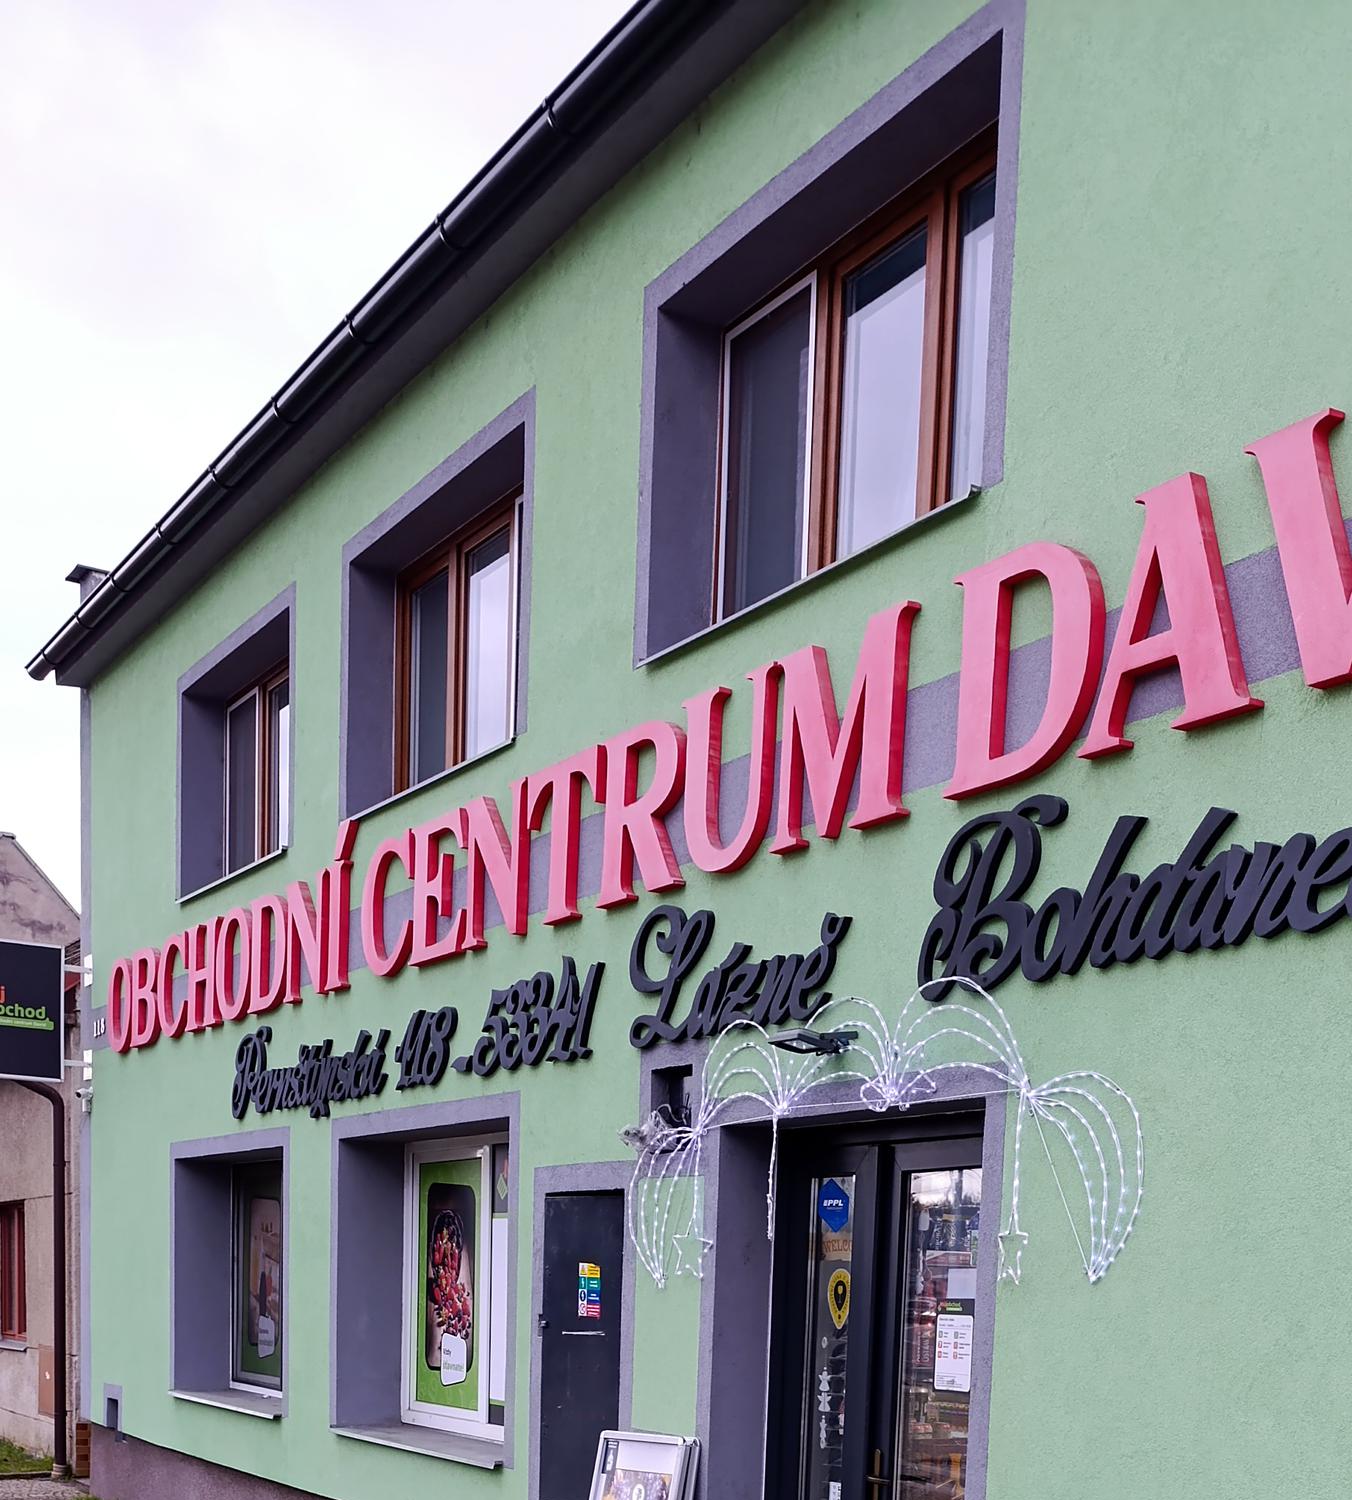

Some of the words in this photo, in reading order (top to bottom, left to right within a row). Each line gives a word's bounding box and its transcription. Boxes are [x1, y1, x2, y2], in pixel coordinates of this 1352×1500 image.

[107, 819, 359, 1053] OBCHODNÍ
[361, 600, 922, 977] CENTRUM
[629, 904, 853, 1048] Lázně
[917, 794, 1352, 1001] Bohdane
[93, 1017, 106, 1037] 118
[827, 1199, 844, 1207] PPL
